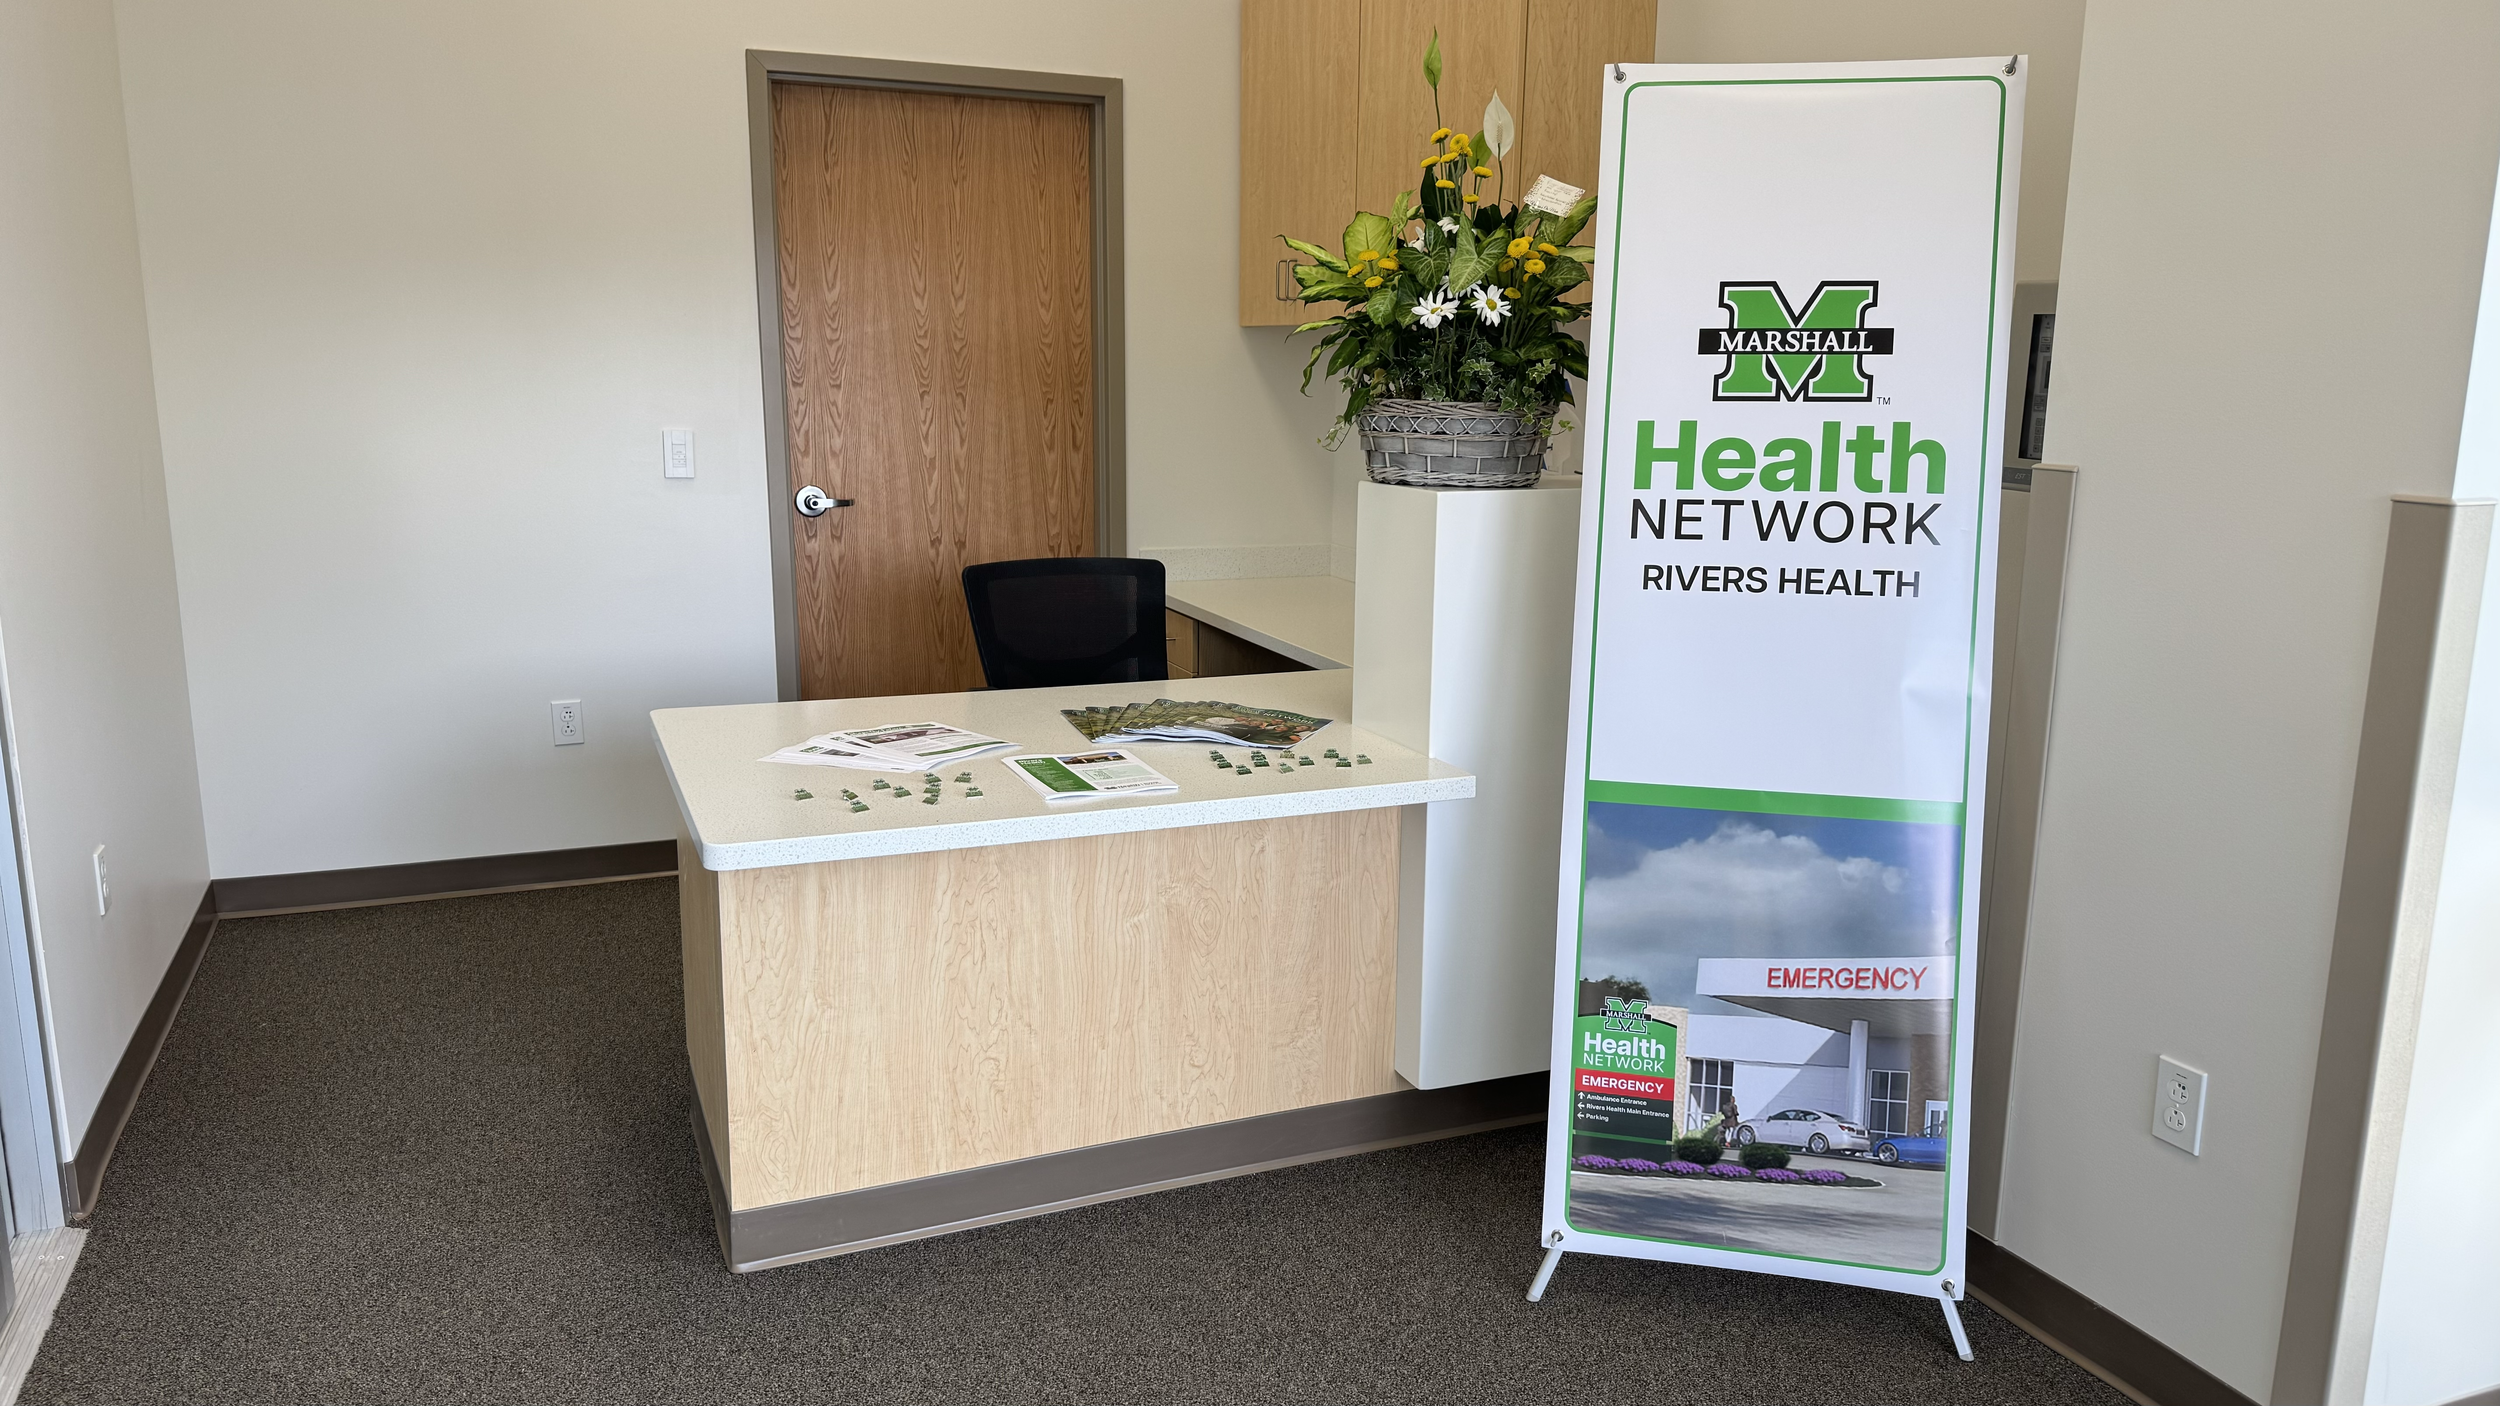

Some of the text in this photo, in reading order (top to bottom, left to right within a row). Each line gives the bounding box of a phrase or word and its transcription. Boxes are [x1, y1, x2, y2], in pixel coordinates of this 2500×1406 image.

[1717, 330, 1873, 353] MARSHALL
[1876, 396, 1891, 405] TM
[1633, 420, 1947, 494] Health
[1630, 498, 1942, 546] NETWORK
[1642, 564, 1920, 598] RIVERS HEALTH
[1766, 966, 1928, 991] EMERGENCY
[1606, 1010, 1646, 1020] MARSHALL
[1584, 1031, 1666, 1060] Health
[1583, 1052, 1664, 1073] NETWORK
[1582, 1074, 1664, 1094] EMERGENCY
[1586, 1094, 1648, 1106] Ambulance Entrance
[1586, 1103, 1605, 1111] Rivers
[1605, 1105, 1626, 1113] Health
[1642, 1109, 1670, 1118] Entrance
[1585, 1113, 1609, 1122] Parking
